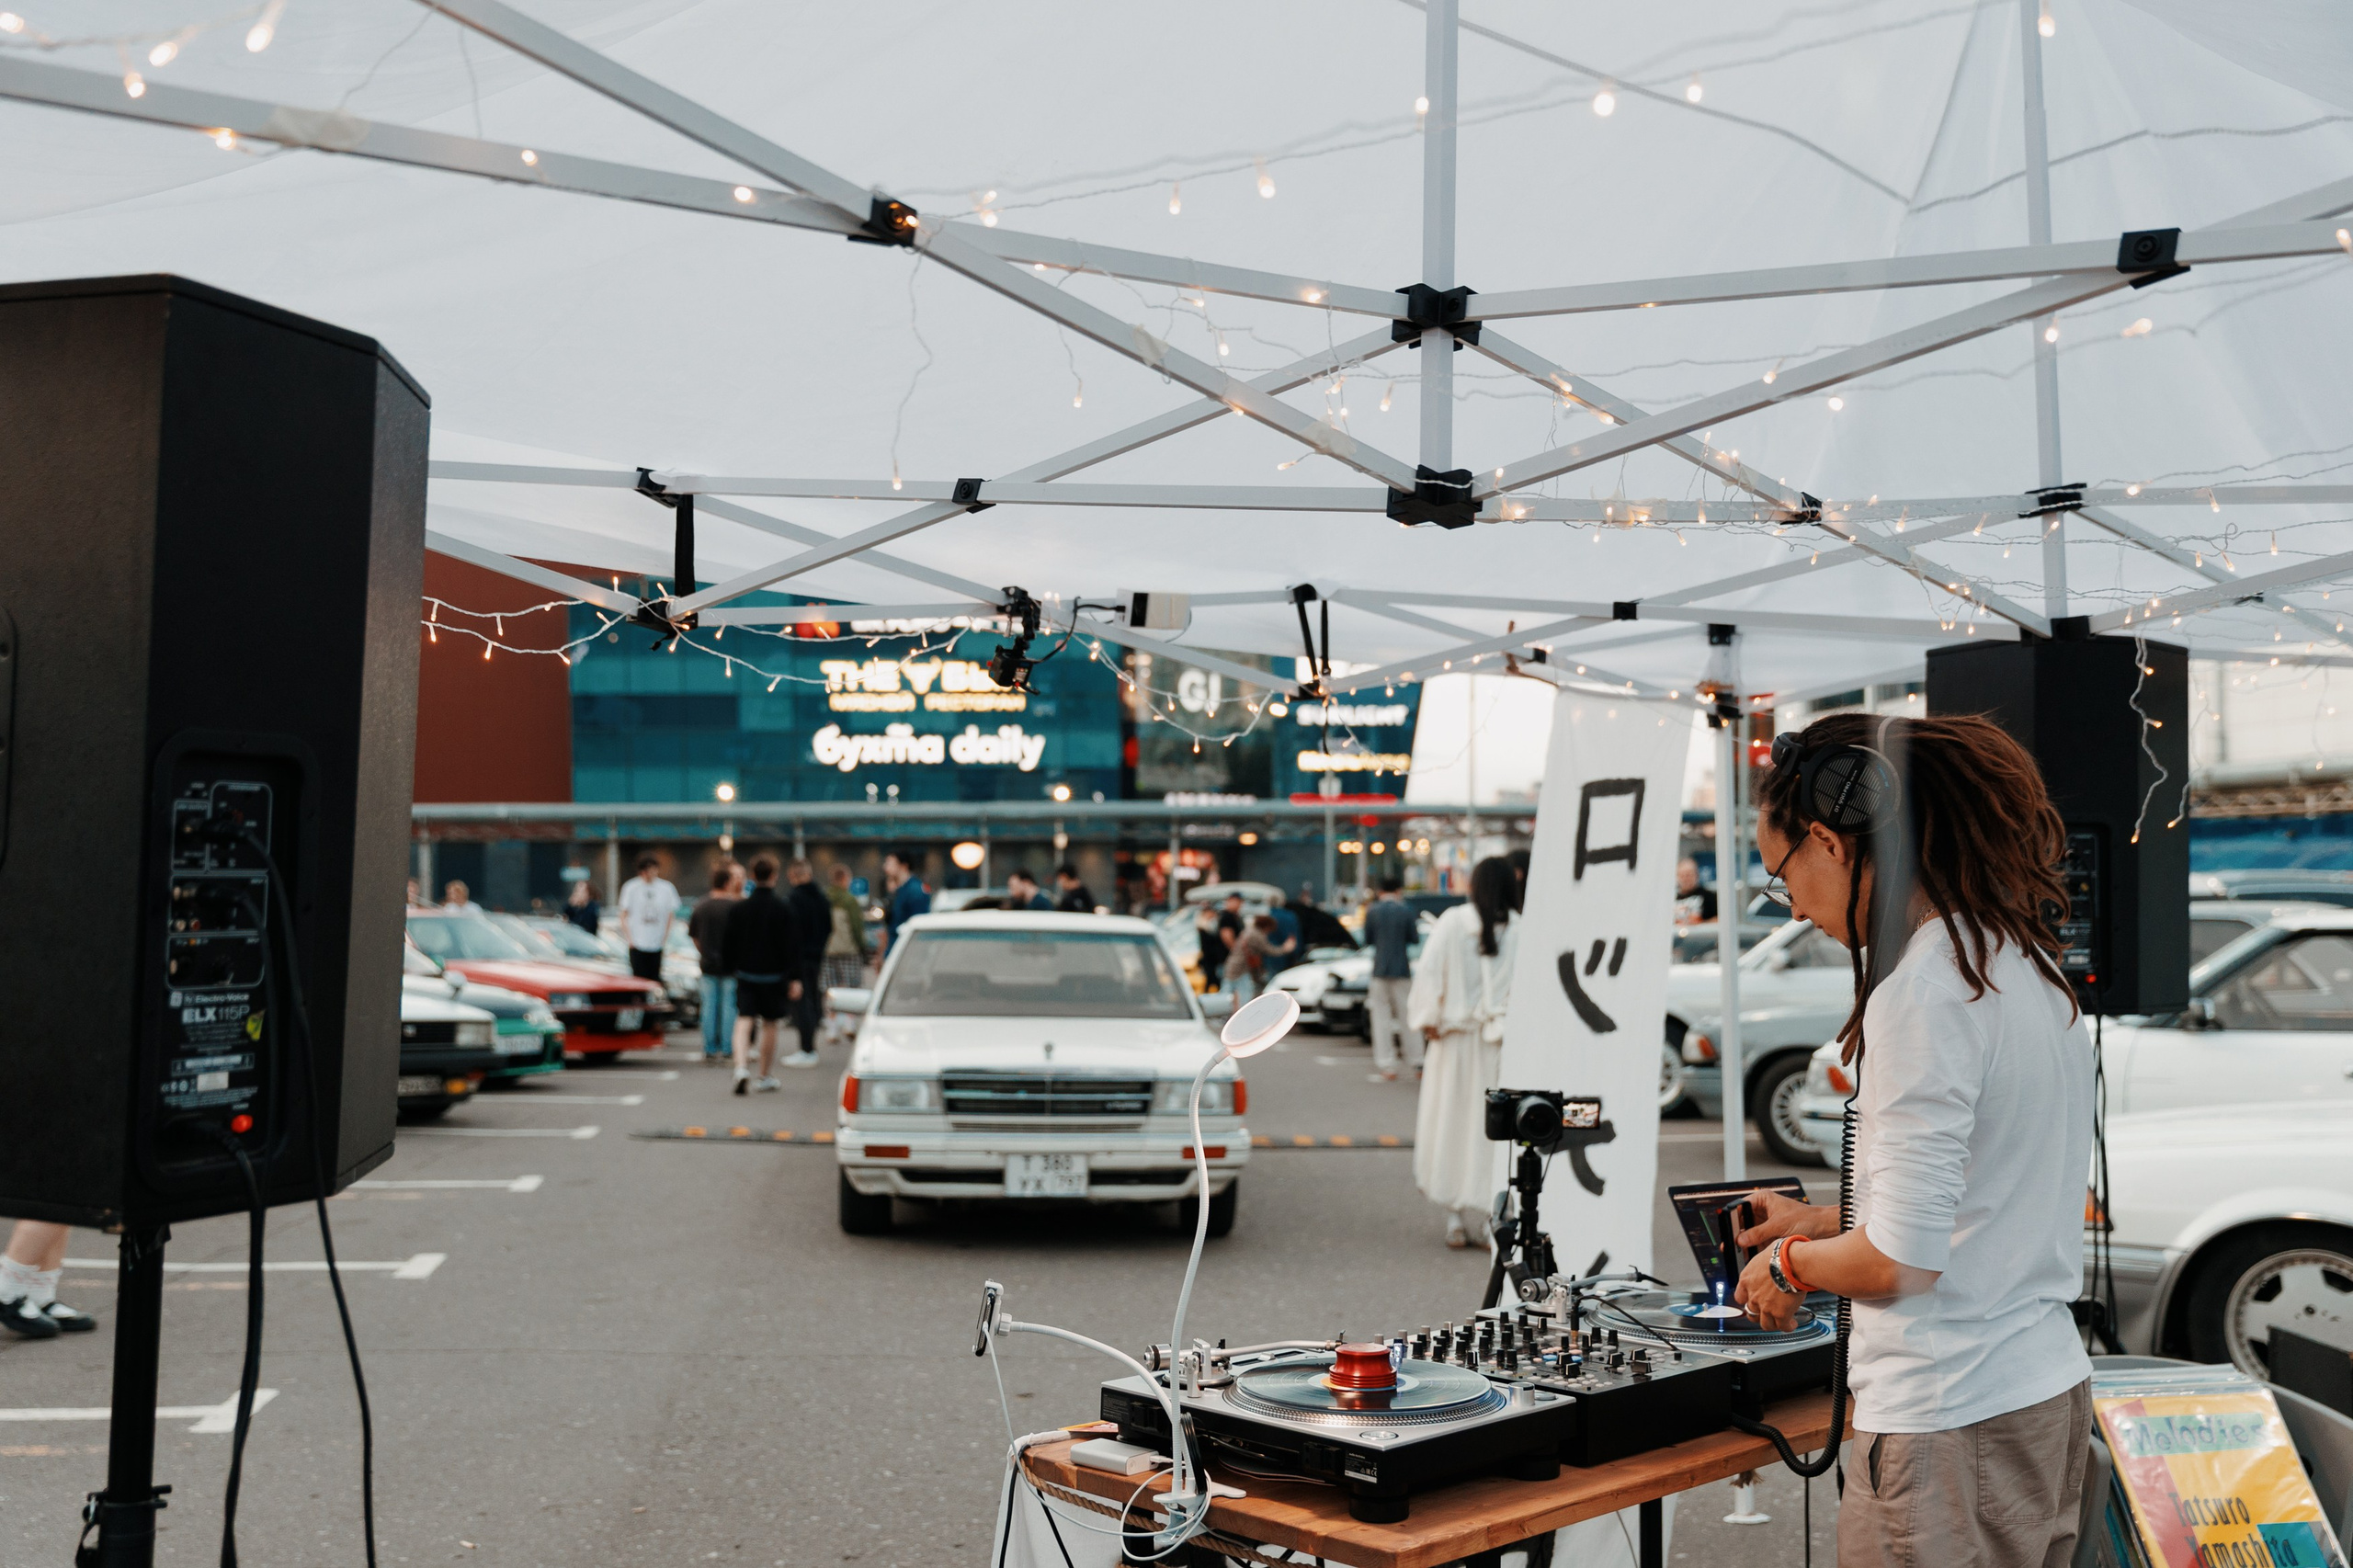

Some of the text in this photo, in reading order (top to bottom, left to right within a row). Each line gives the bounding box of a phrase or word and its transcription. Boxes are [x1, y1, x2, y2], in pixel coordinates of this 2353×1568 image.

[949, 724, 1046, 772] daily
[1838, 792, 1847, 804] 990
[1843, 781, 1852, 793] PRO
[1040, 1153, 1074, 1172] 380
[2168, 1492, 2251, 1528] Tatsuro
[2185, 1532, 2300, 1568] Yamashita
